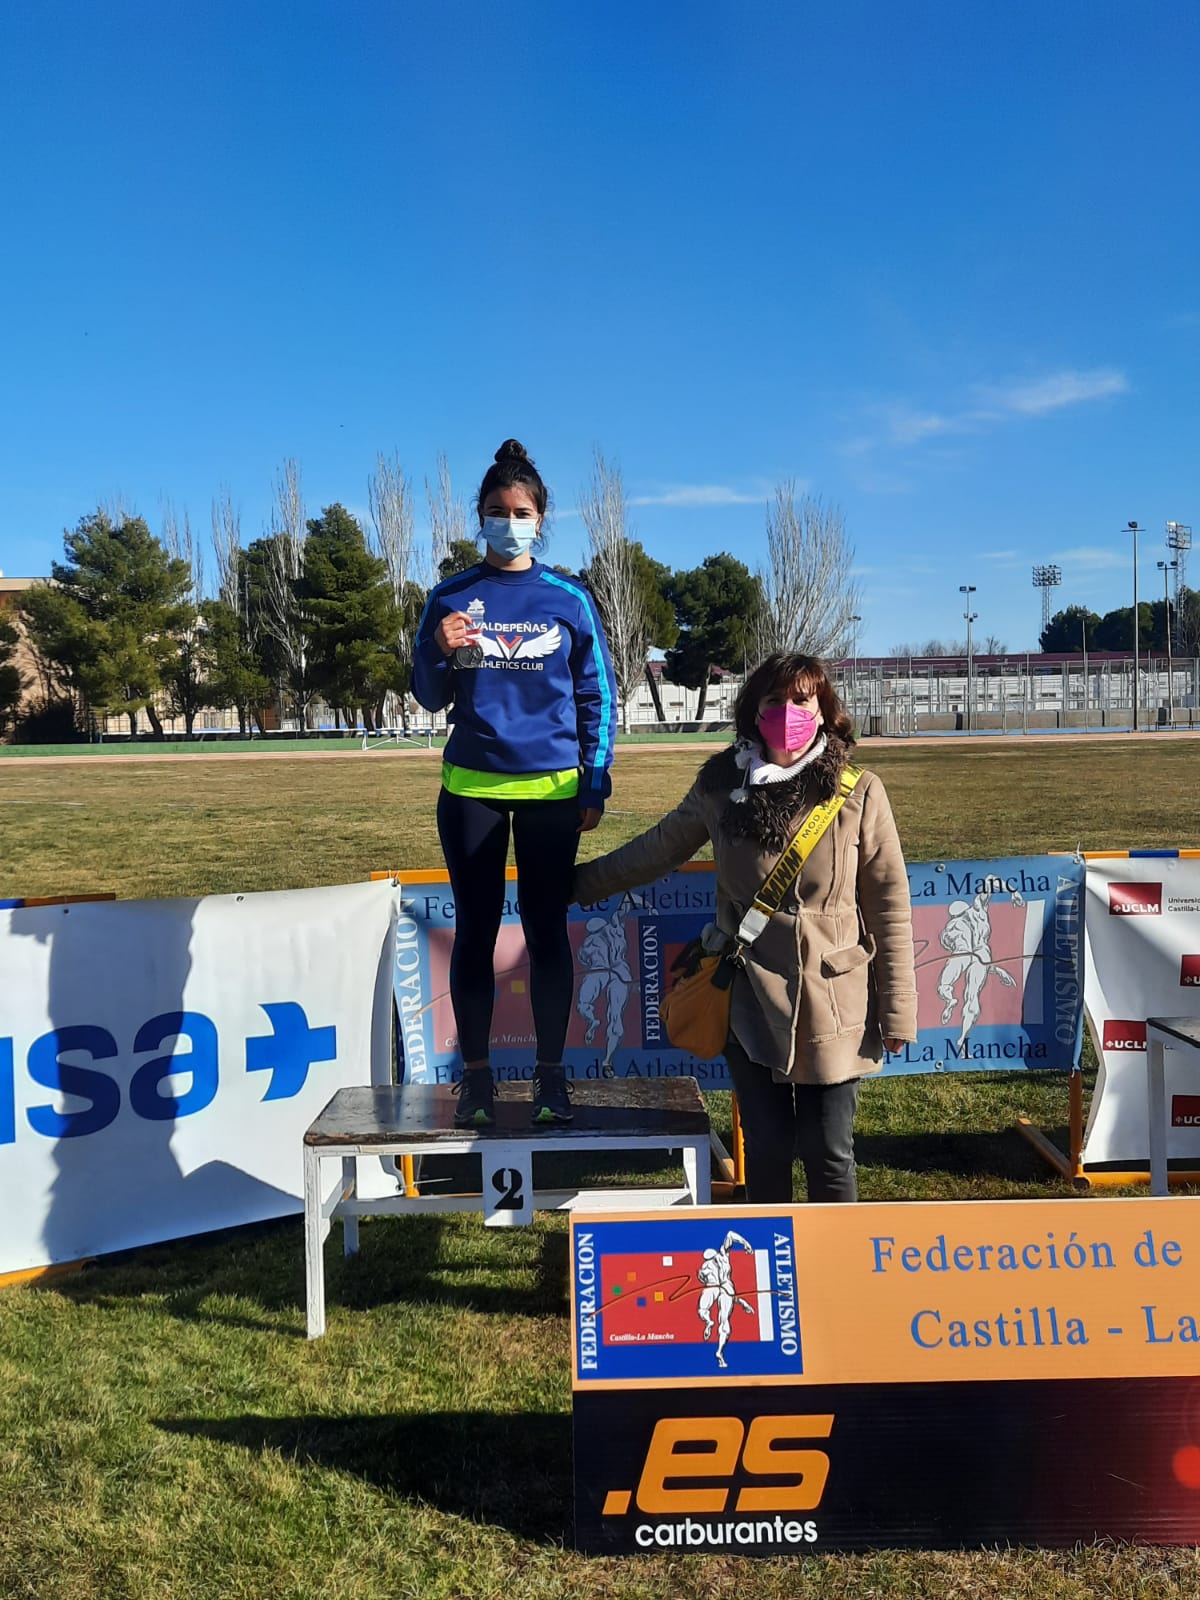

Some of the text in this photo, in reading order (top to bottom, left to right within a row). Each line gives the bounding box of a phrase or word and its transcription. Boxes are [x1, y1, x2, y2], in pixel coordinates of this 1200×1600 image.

[473, 620, 548, 633] VALDEPEÑAS
[478, 660, 544, 671] THLETICS CLUB
[814, 796, 840, 836] MOVEMEN
[946, 868, 1051, 897] Mancha
[1121, 903, 1159, 913] UCLM
[1055, 875, 1080, 1047] ATLETISMO
[643, 924, 661, 1041] FEDERACION
[500, 1033, 537, 1045] Manch
[944, 1036, 1048, 1061] Mancha
[492, 1168, 524, 1210] 2
[869, 1230, 1183, 1273] Federación de
[578, 1233, 598, 1370] FEDERACION
[773, 1232, 798, 1356] ATLETISMO
[910, 1305, 1090, 1349] Castilla
[1140, 1304, 1200, 1344] La
[635, 1515, 818, 1547] carburantes
